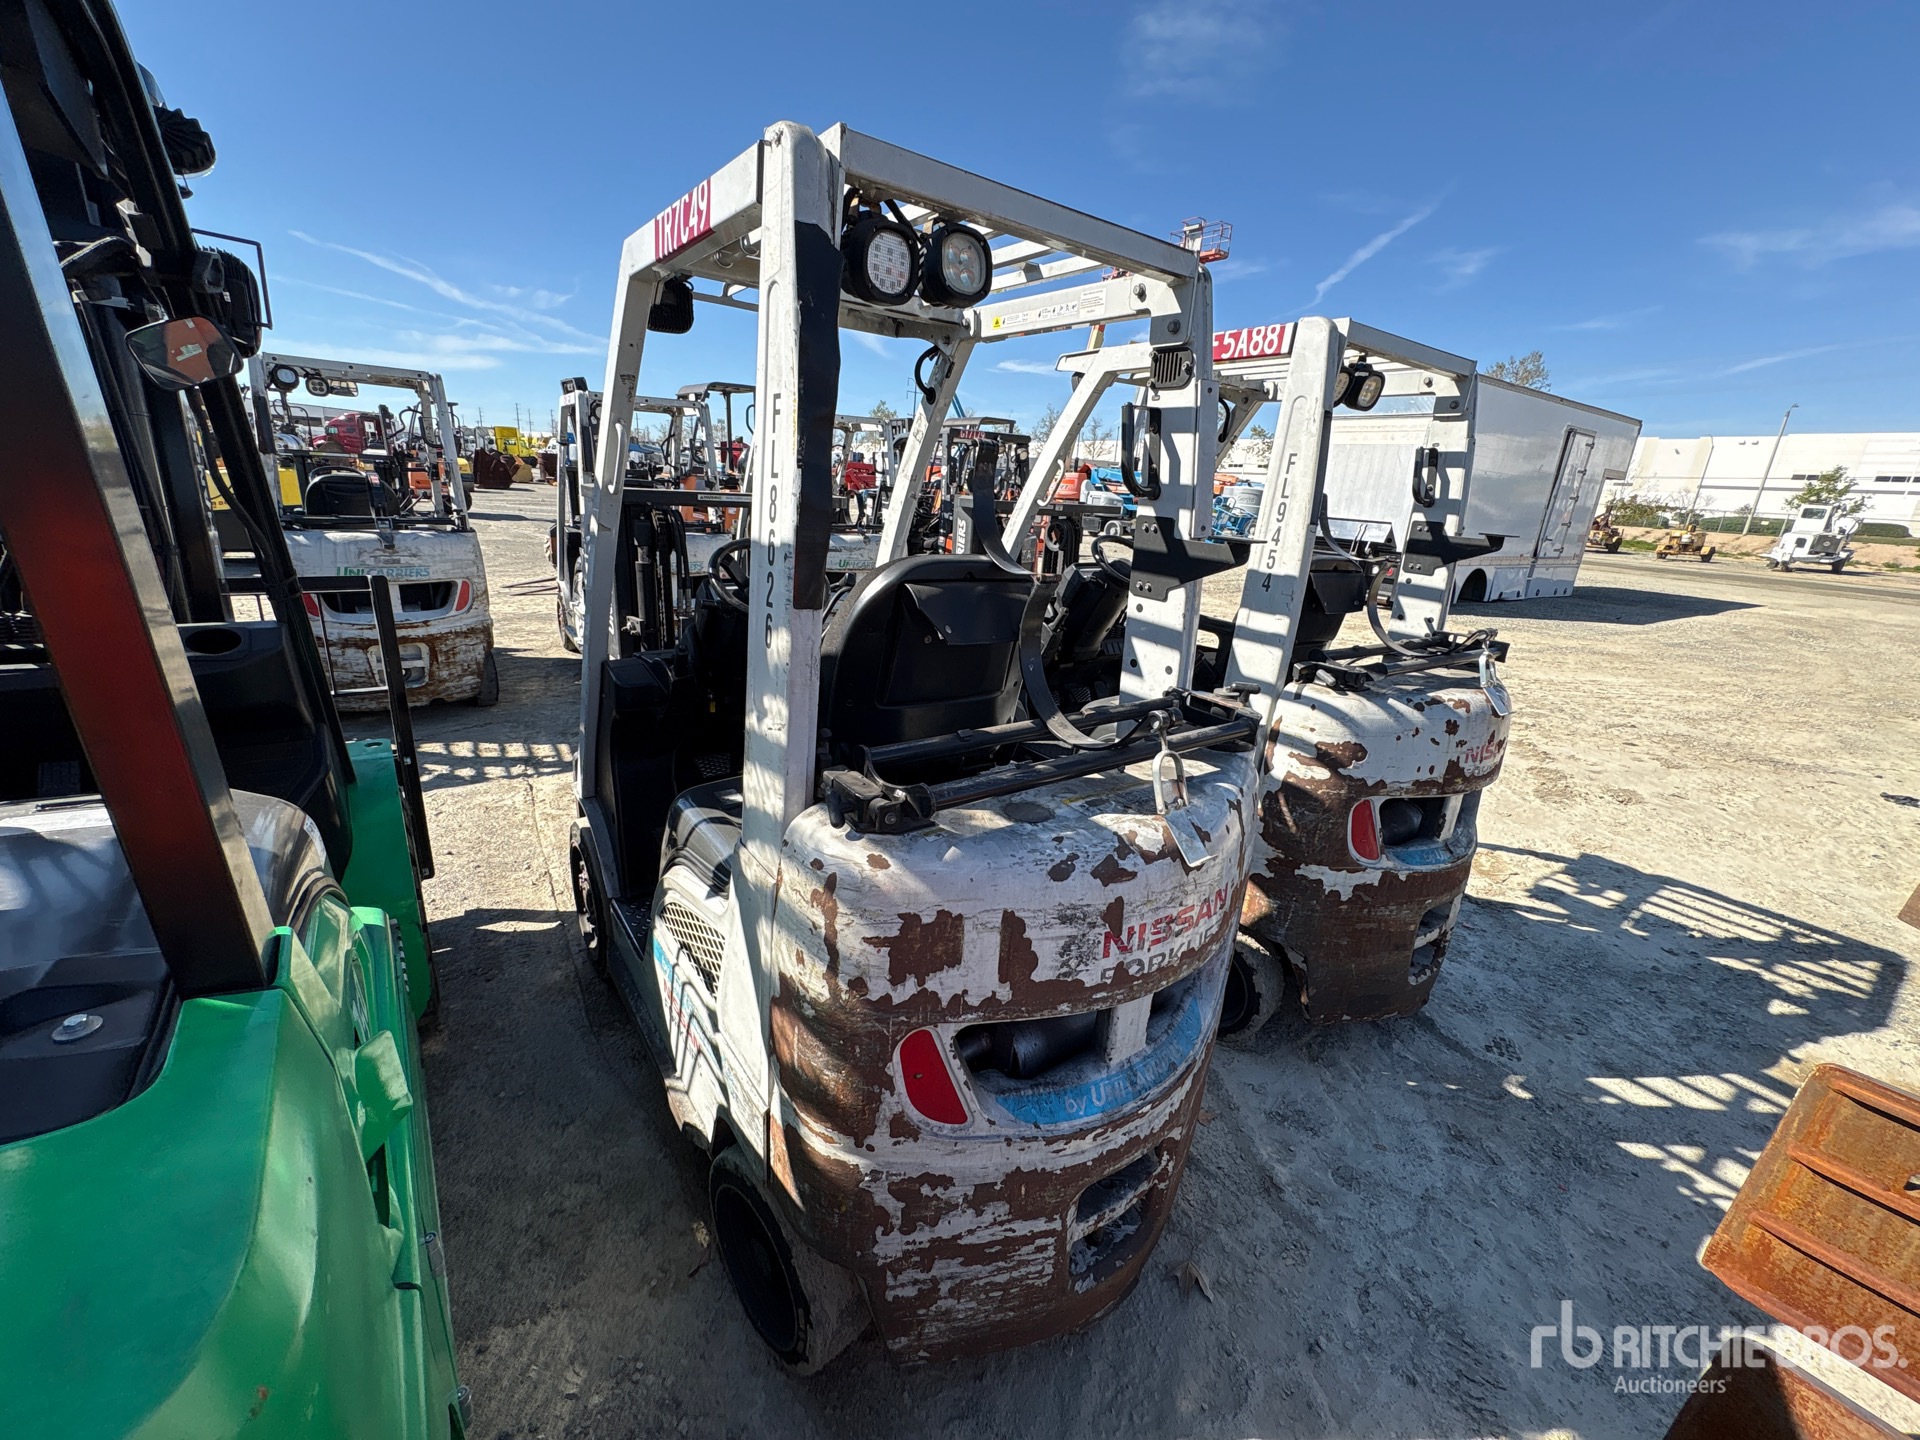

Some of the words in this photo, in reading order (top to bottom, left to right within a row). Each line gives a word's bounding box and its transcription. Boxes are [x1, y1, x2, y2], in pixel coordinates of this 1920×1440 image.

[656, 179, 709, 259] TR7C49
[764, 392, 782, 650] FL8626
[1261, 452, 1298, 593] FL9454
[1102, 882, 1229, 959] NISSAN
